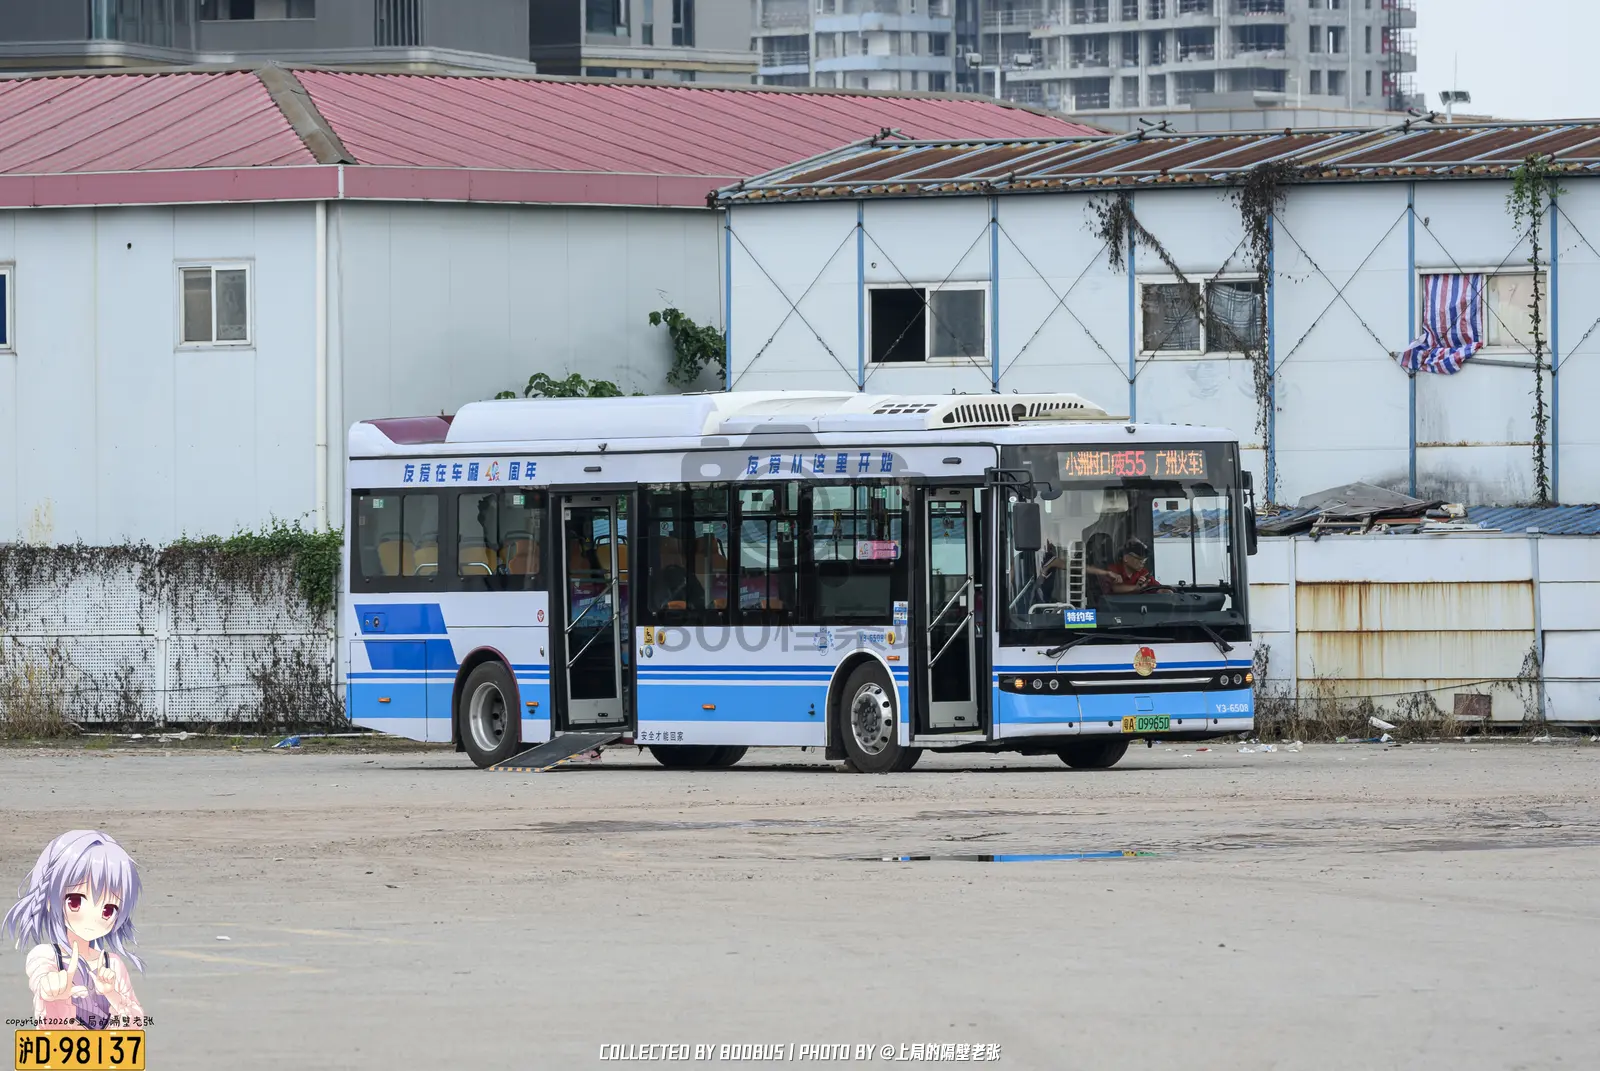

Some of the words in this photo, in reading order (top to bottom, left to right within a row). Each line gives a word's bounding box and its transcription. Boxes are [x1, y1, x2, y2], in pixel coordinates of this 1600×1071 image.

[746, 452, 893, 474] 友爱从这里开始
[1066, 611, 1095, 622] 特约车
[1215, 703, 1249, 713] Y3-6508
[641, 731, 684, 741] 安全才能回家
